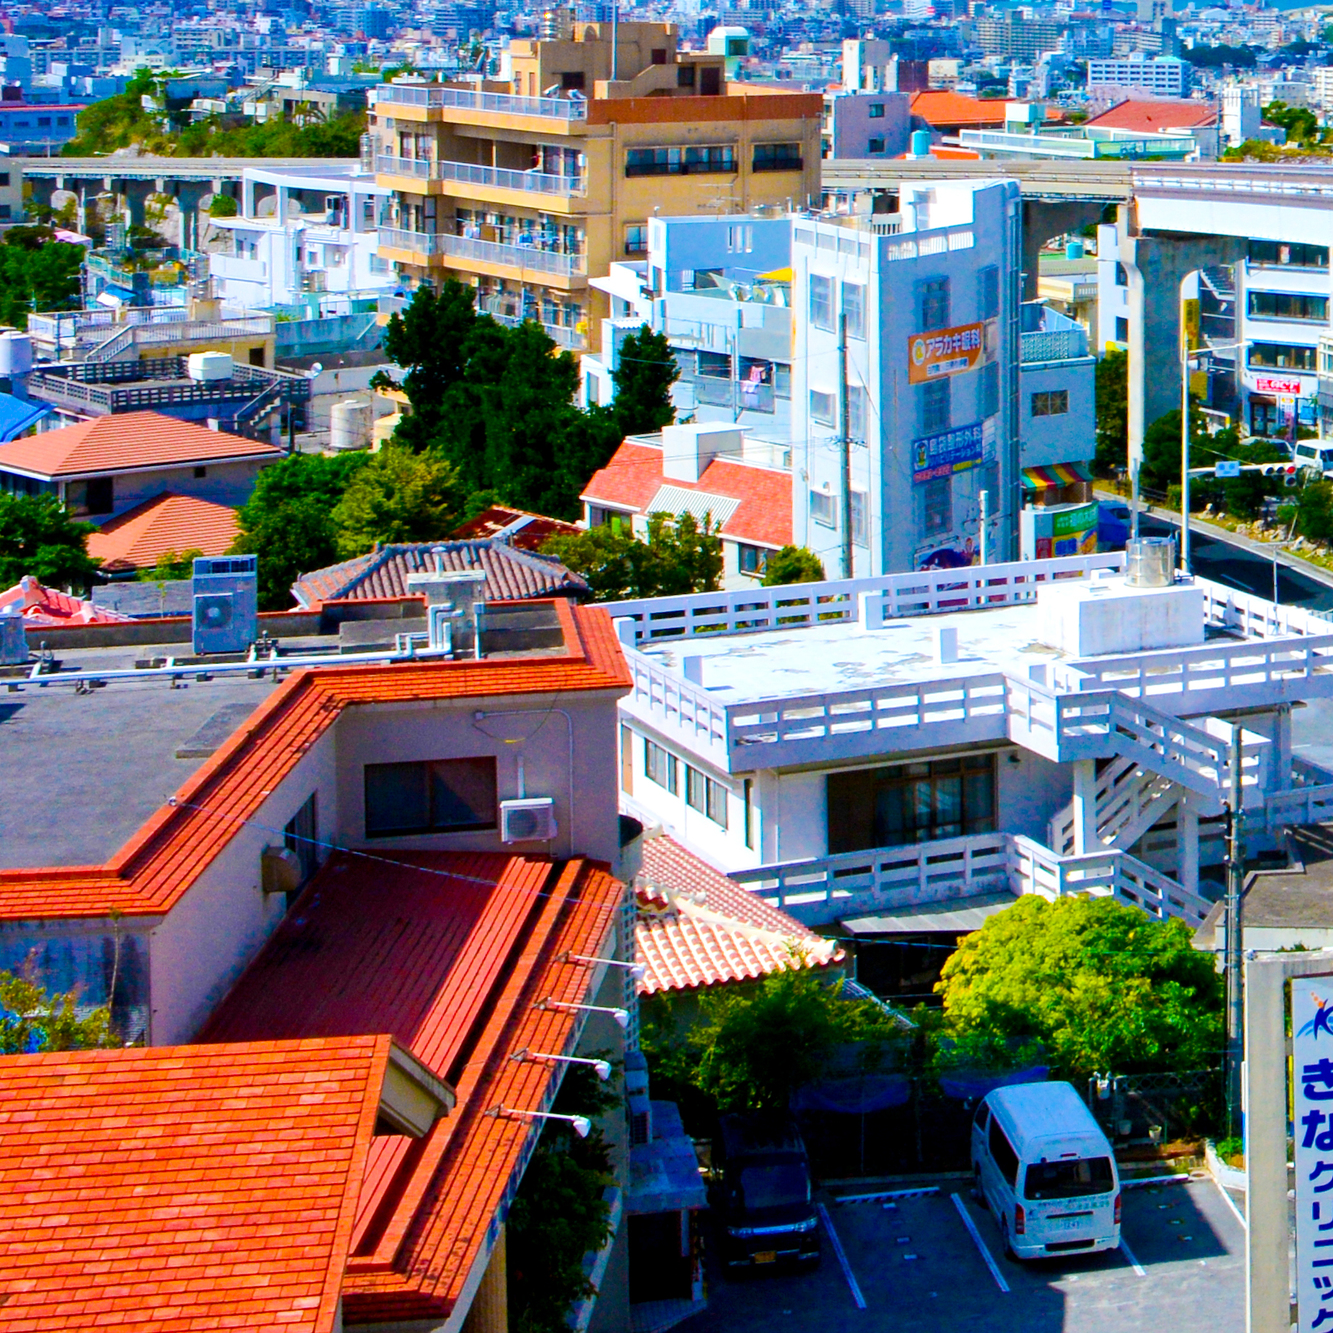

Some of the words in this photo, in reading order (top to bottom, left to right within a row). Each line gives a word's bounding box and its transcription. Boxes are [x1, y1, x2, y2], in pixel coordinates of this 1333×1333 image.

[926, 328, 981, 359] アラカキ眼科
